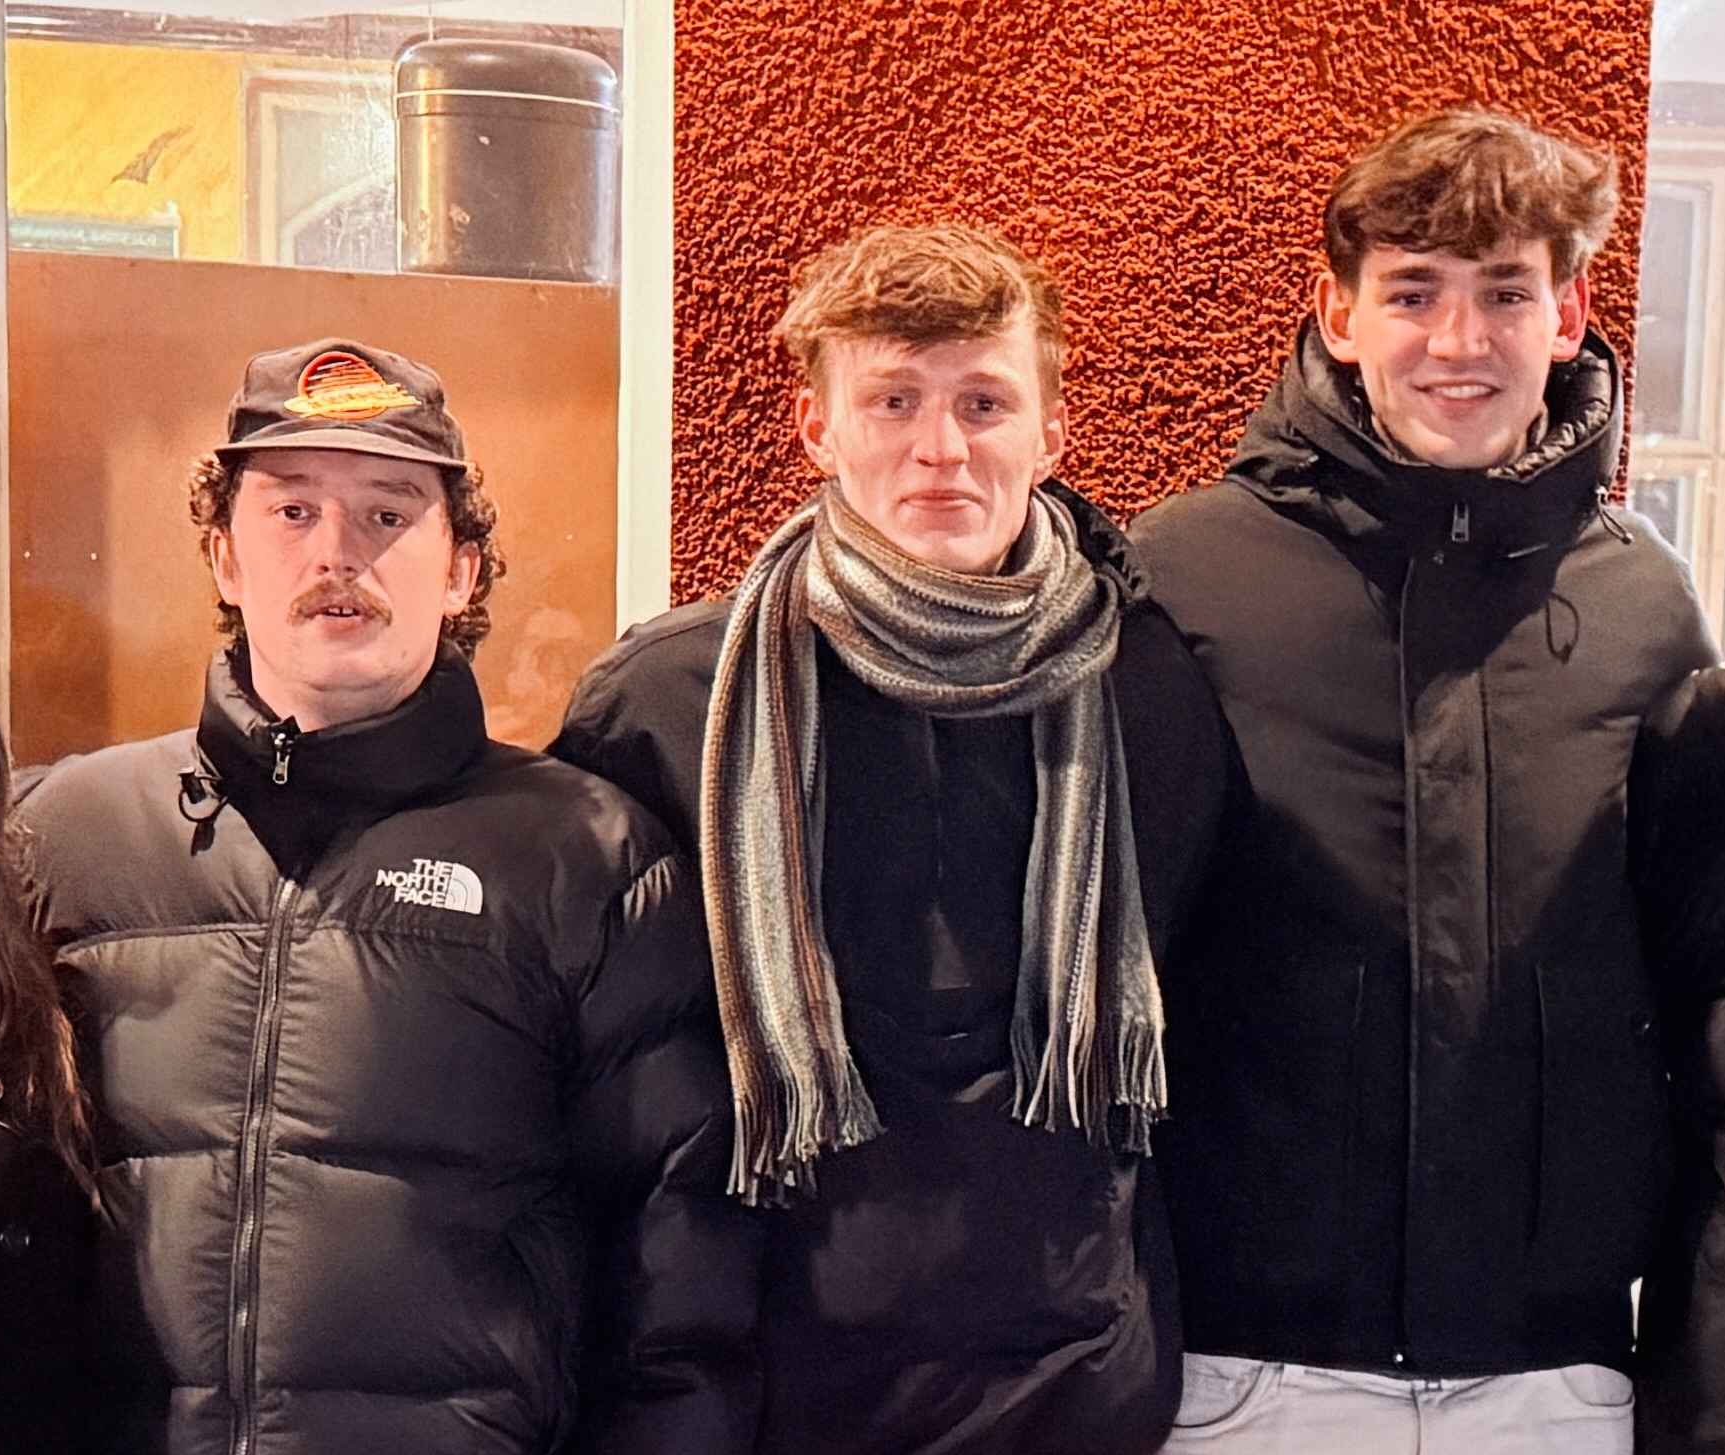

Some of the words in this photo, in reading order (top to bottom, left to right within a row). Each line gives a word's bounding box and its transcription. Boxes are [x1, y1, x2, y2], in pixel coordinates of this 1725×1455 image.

[412, 858, 453, 876] THE
[375, 868, 450, 893] NORTH
[394, 886, 446, 908] FACE
